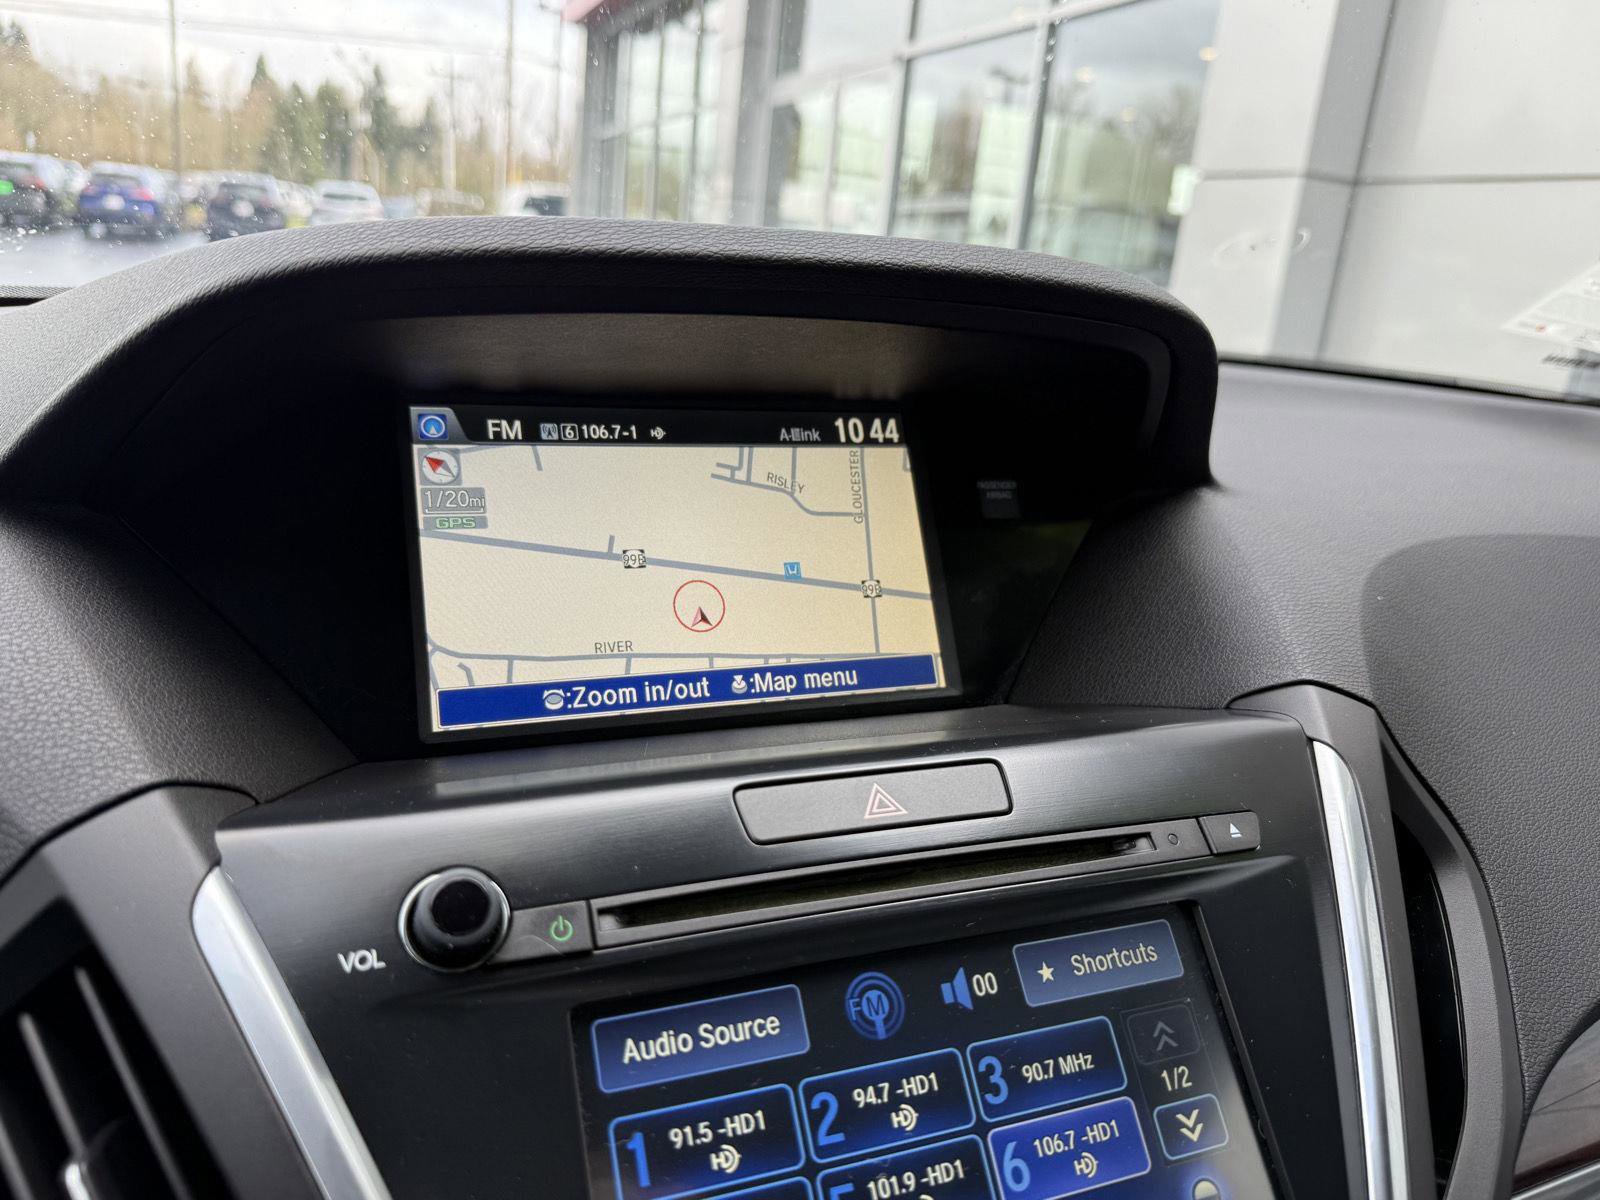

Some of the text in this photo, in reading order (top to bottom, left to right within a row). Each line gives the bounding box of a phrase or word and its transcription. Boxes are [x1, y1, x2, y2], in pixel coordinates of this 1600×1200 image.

[486, 419, 523, 440] FM
[565, 425, 575, 439] 6
[581, 425, 637, 440] 106.7-1
[834, 417, 864, 443] 10
[869, 417, 899, 443] 44
[767, 471, 805, 494] RISLEY
[850, 449, 864, 524] GLOUCESTER
[435, 517, 476, 529] GPS
[594, 640, 633, 654] RIVER
[643, 676, 710, 703] in/out
[804, 669, 858, 689] menu
[337, 948, 386, 973] VOL
[1070, 942, 1158, 977] Shortcuts
[972, 972, 998, 997] 00
[622, 1015, 781, 1064] Audio Source
[977, 1055, 1009, 1105] 3
[1021, 1051, 1095, 1084] 90.7 MHz
[1161, 1066, 1193, 1092] 1/2
[853, 1082, 890, 1109] 94.7
[810, 1091, 846, 1147] 2
[668, 1120, 713, 1150] 91.5
[1033, 1130, 1076, 1158] 106.7
[626, 1131, 651, 1188] 1
[1002, 1141, 1032, 1192] 6
[867, 1171, 917, 1200] 101.9
